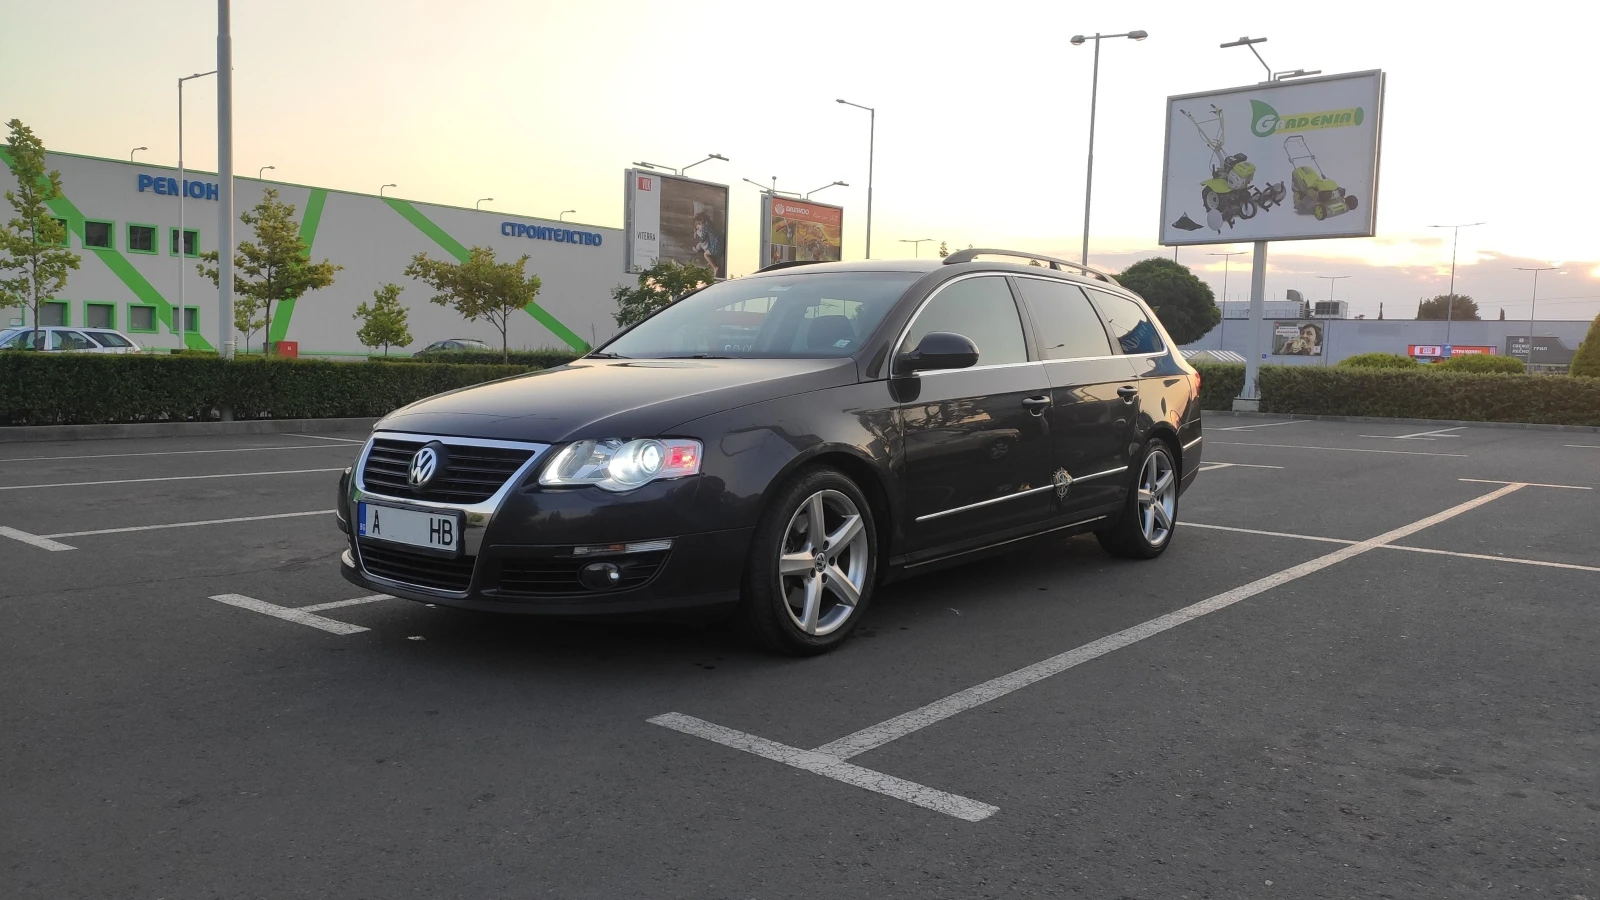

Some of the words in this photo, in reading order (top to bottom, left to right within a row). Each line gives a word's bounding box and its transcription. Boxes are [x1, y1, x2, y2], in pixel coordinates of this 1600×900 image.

[138, 174, 219, 201] РЕМОН
[501, 221, 603, 247] СТРОИТЕЛСТВО
[637, 231, 656, 241] VITERRA
[372, 509, 381, 535] A
[429, 517, 453, 546] HB
